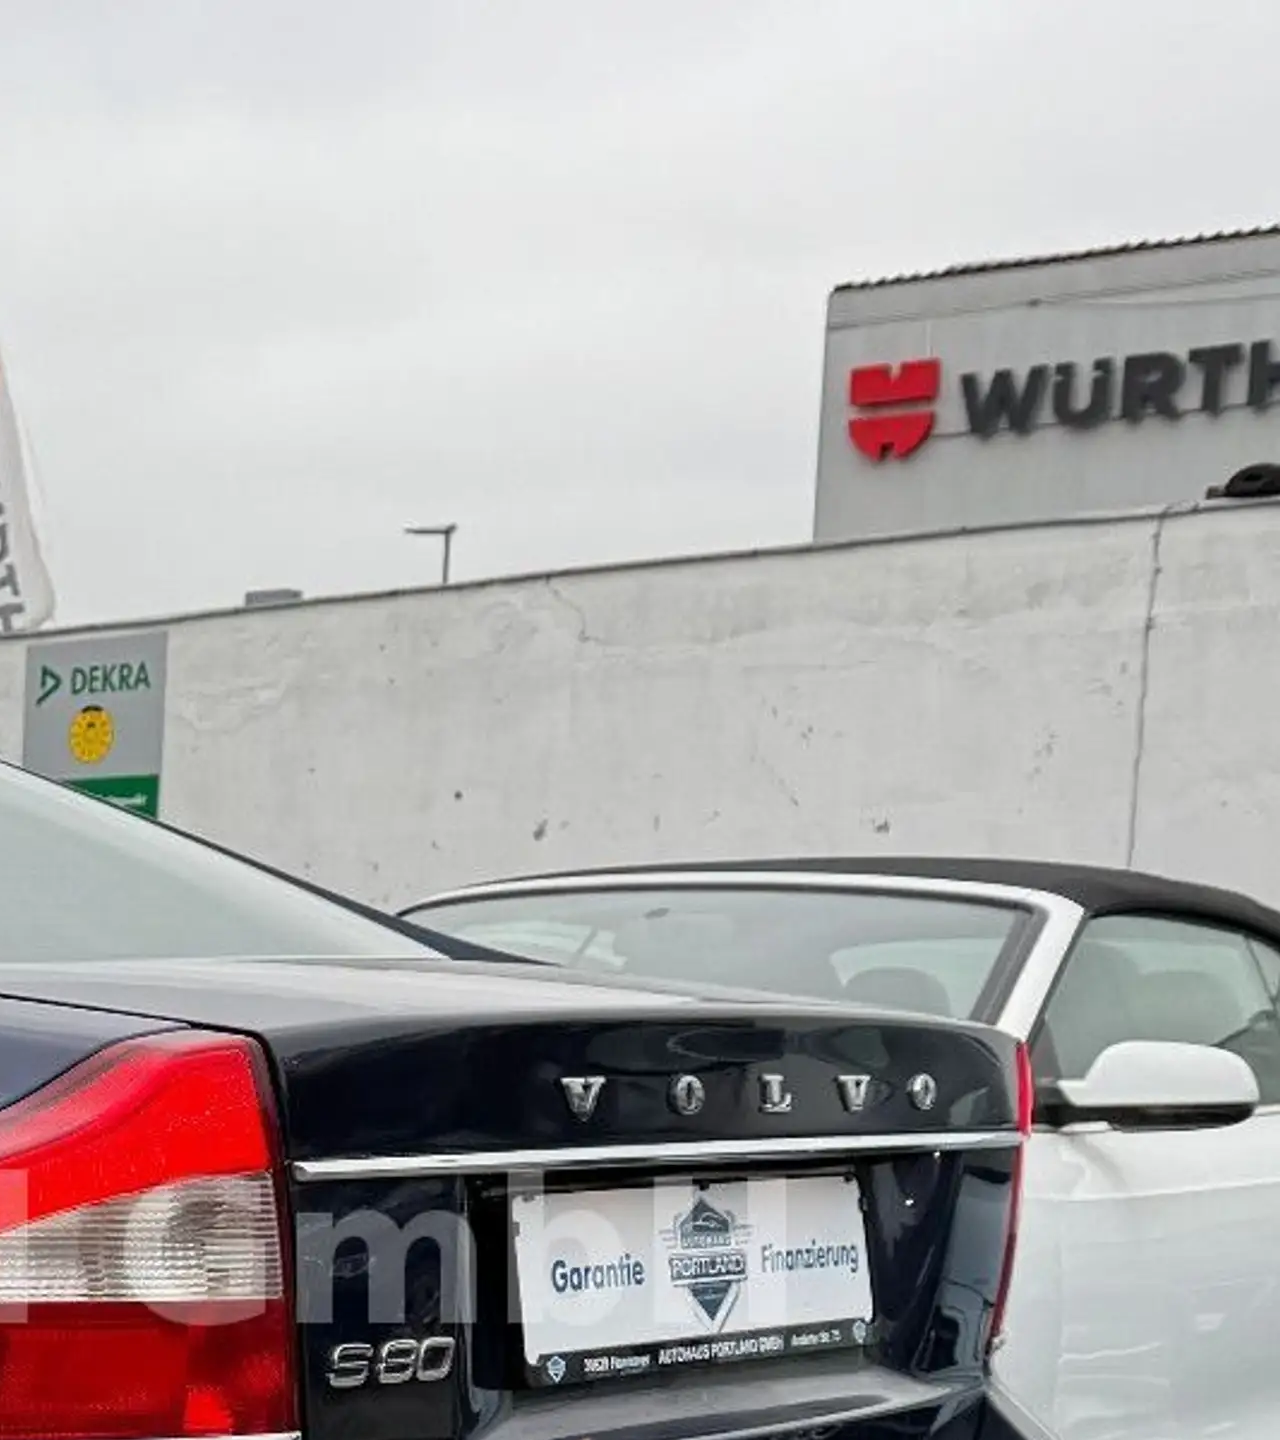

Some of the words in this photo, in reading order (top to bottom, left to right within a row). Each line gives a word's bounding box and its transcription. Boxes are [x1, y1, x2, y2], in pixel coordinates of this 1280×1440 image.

[71, 661, 151, 695] DEKRA
[559, 1072, 937, 1121] VOLVO
[551, 1252, 646, 1293] Garantie
[671, 1255, 744, 1279] PORTLAND
[761, 1238, 859, 1274] Finanzierung
[325, 1336, 456, 1388] S80
